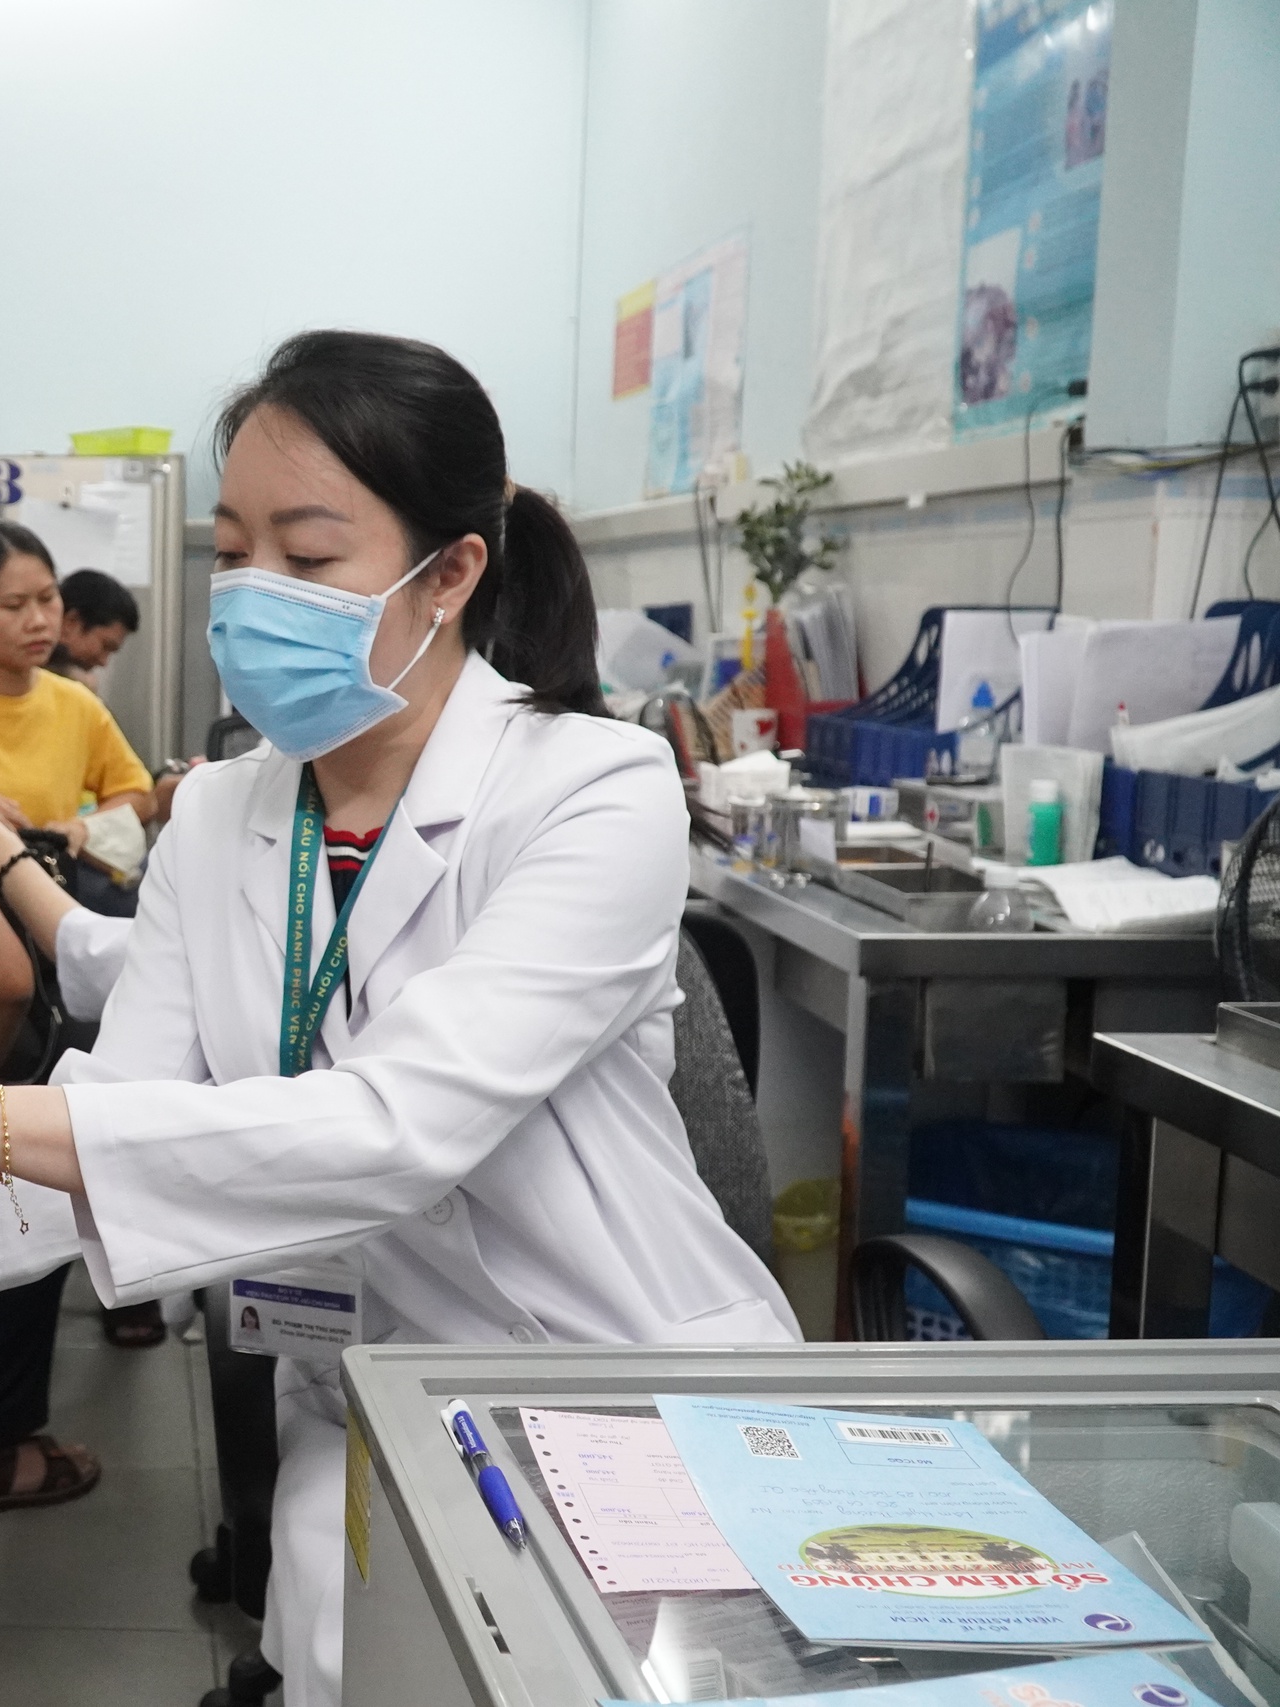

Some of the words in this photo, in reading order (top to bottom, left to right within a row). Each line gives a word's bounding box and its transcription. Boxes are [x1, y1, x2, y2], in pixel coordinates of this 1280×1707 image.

[298, 851, 311, 878] NỐI
[295, 882, 307, 915] CHO
[330, 936, 348, 968] CHO
[790, 1575, 937, 1591] CHỦNG
[944, 1575, 1047, 1589] TIÊM
[1051, 1573, 1108, 1590] SỔ
